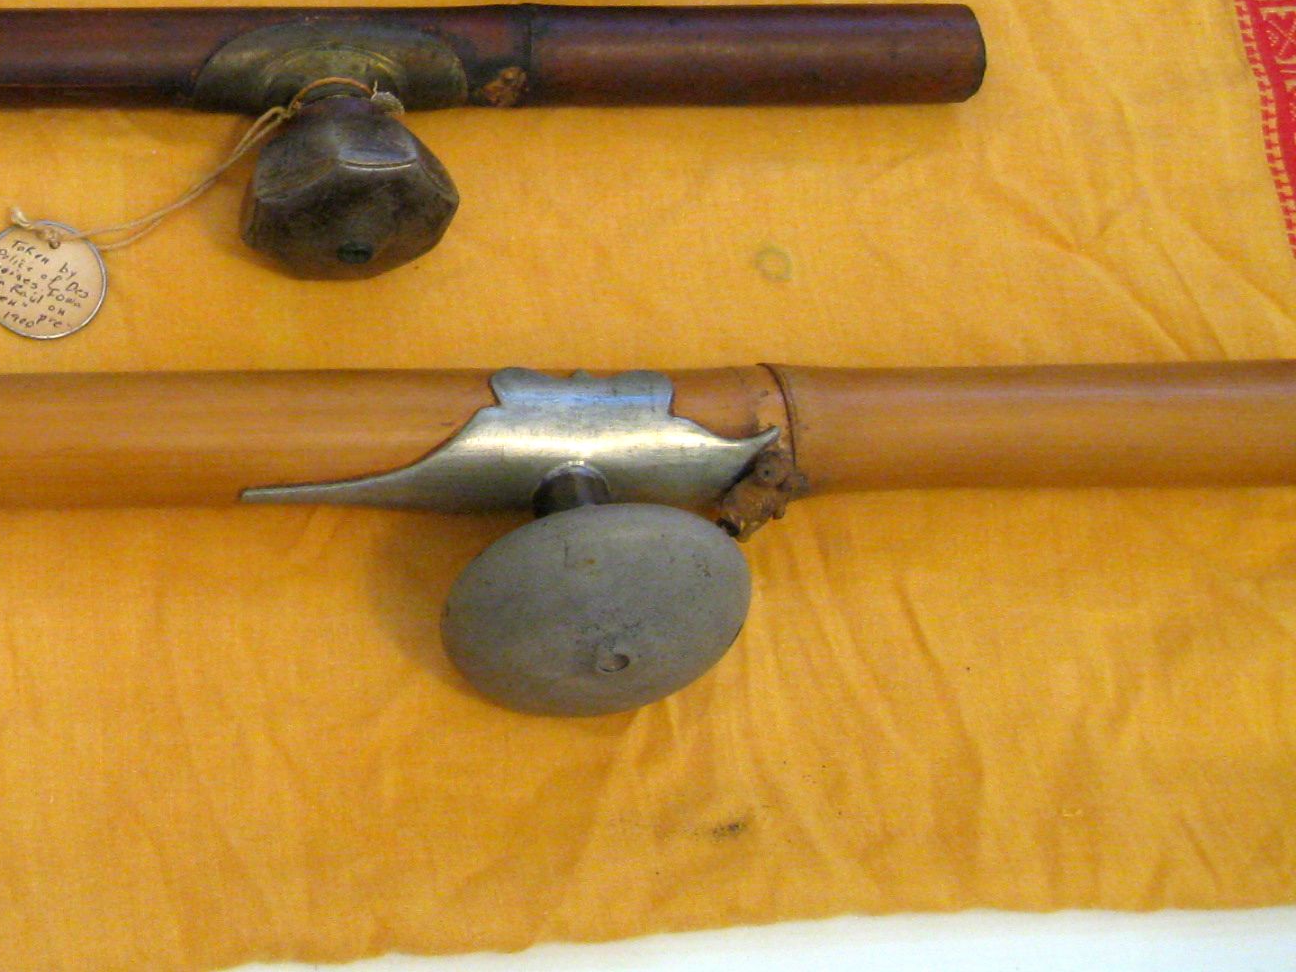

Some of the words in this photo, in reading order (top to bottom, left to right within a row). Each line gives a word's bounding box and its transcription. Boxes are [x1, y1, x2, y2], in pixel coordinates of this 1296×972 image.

[11, 240, 50, 265] Taken
[59, 262, 78, 282] by
[40, 272, 62, 290] of
[10, 284, 44, 304] Raid
[47, 304, 66, 316] on
